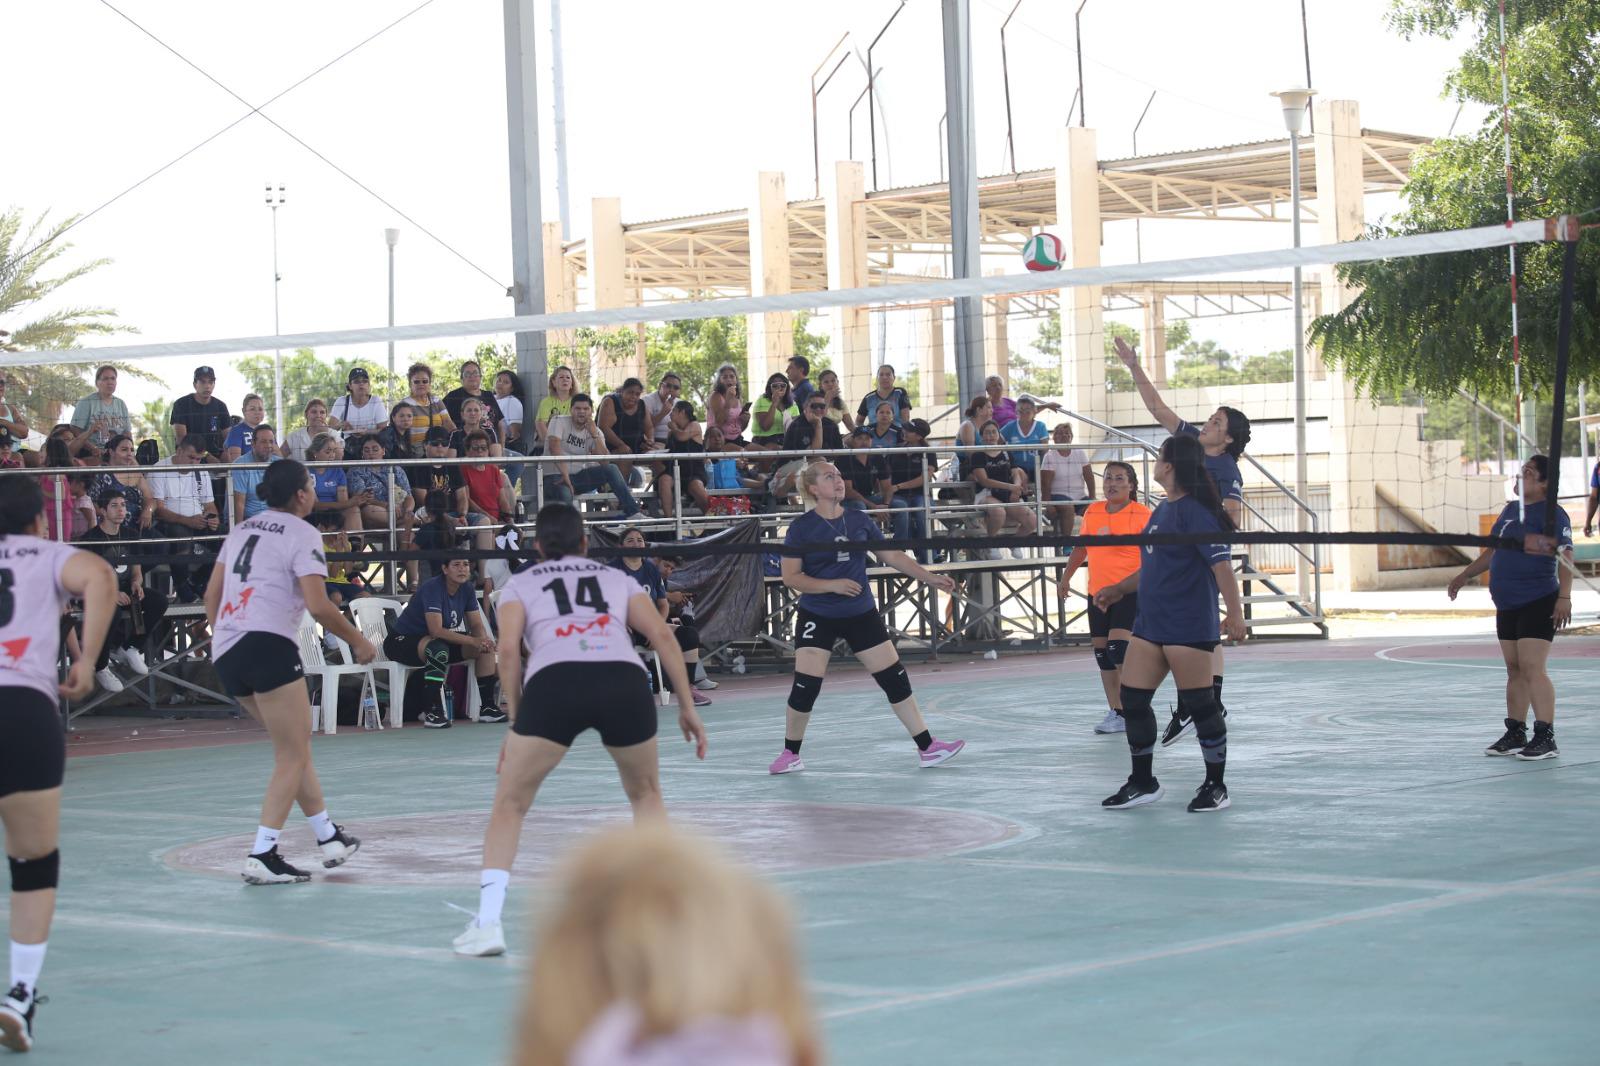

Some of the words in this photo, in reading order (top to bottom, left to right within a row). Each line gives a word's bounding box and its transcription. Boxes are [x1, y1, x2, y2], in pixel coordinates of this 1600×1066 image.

[241, 520, 286, 535] SINALOA
[232, 534, 261, 583] 4
[531, 563, 610, 576] SINALOA
[542, 575, 609, 616] 14
[450, 610, 458, 628] 3
[802, 621, 817, 639] 2
